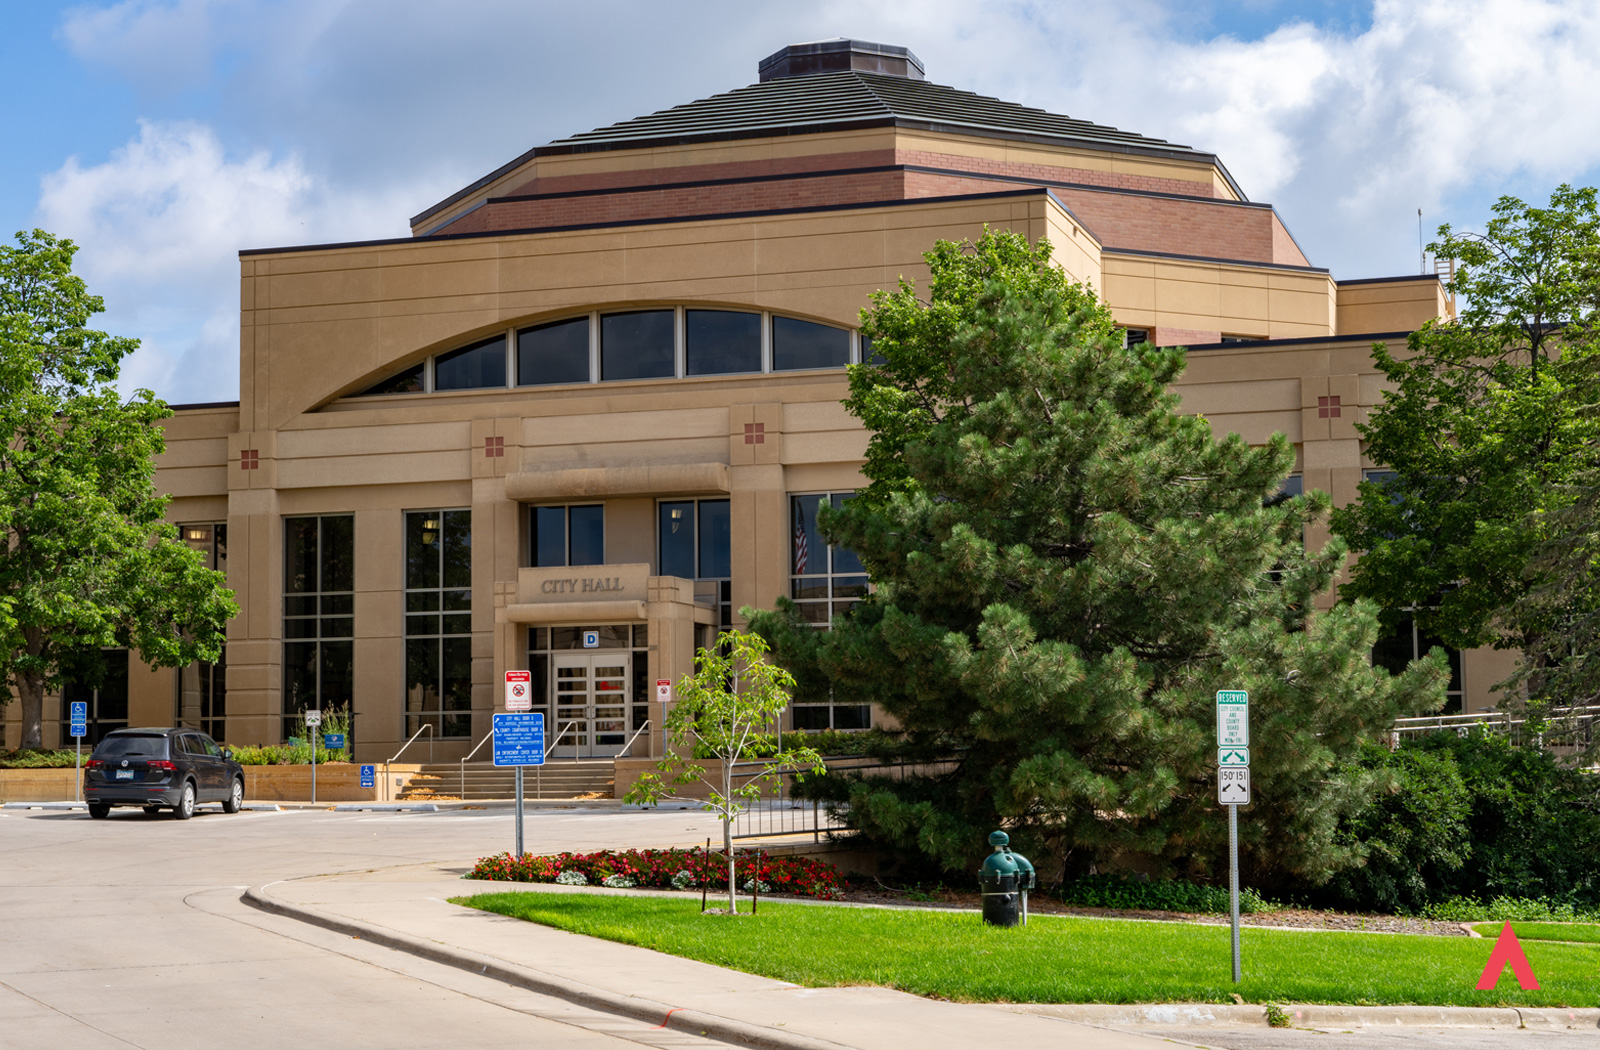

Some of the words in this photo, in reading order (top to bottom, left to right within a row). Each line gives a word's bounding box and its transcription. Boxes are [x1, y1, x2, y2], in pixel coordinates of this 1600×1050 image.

[541, 579, 578, 593] CITY
[581, 577, 625, 592] HALL
[587, 635, 596, 644] D
[1219, 693, 1246, 703] RESERVED
[1221, 771, 1233, 780] 150
[1235, 771, 1246, 780] 151
